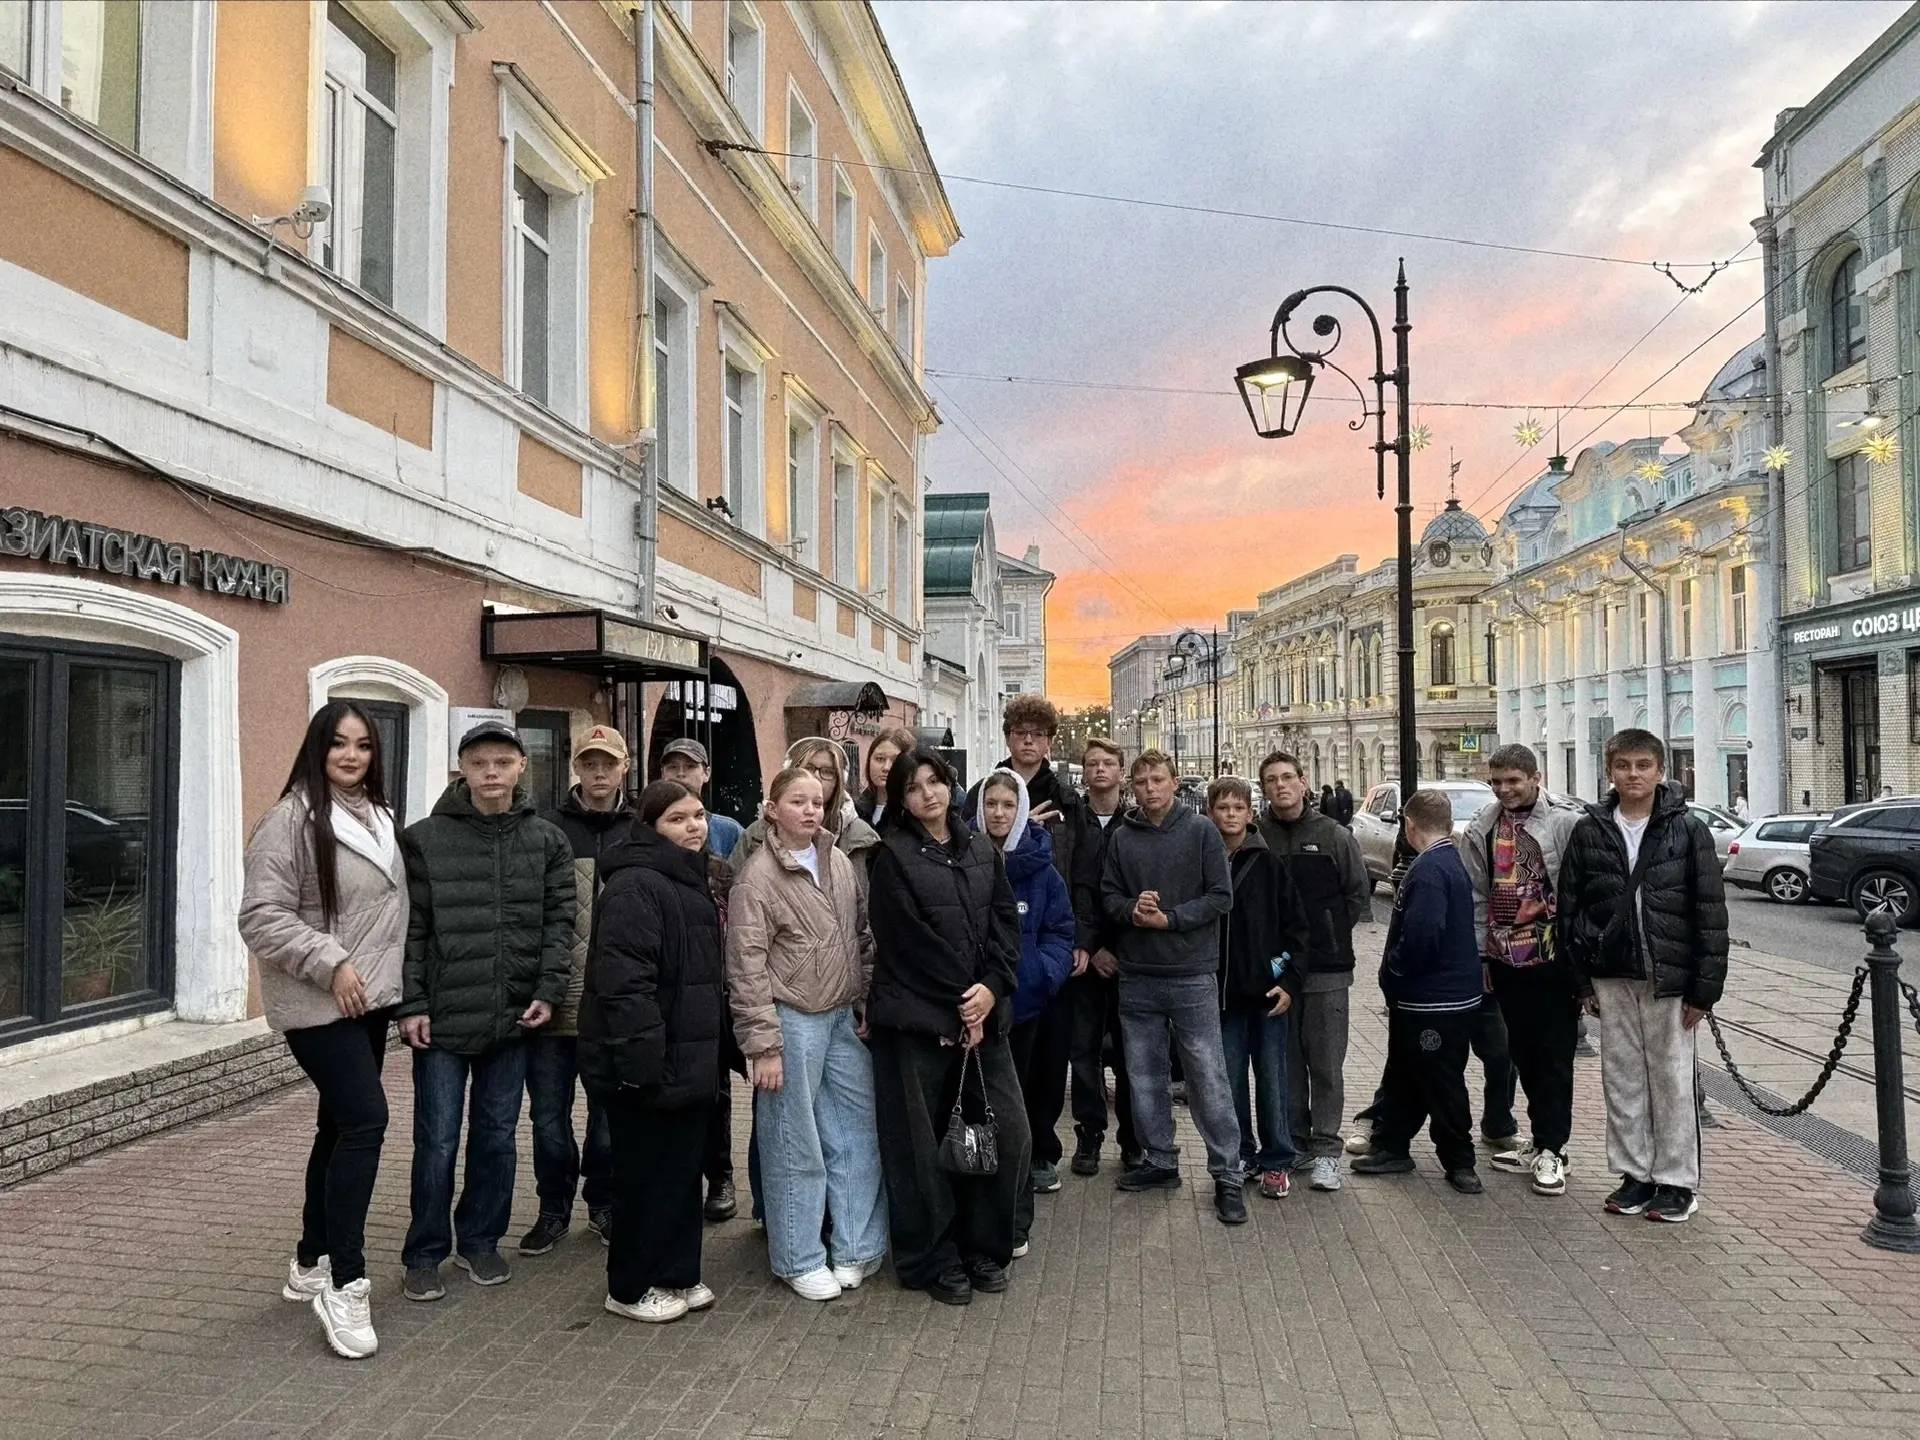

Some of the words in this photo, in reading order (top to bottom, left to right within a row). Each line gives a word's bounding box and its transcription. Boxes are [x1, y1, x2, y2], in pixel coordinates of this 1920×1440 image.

[0, 506, 190, 586] ЗИАТСКАЯ
[201, 549, 289, 604] КУХНЯ
[1794, 626, 1838, 643] РЕСТОРАН
[1852, 613, 1898, 637] СОЮЗ
